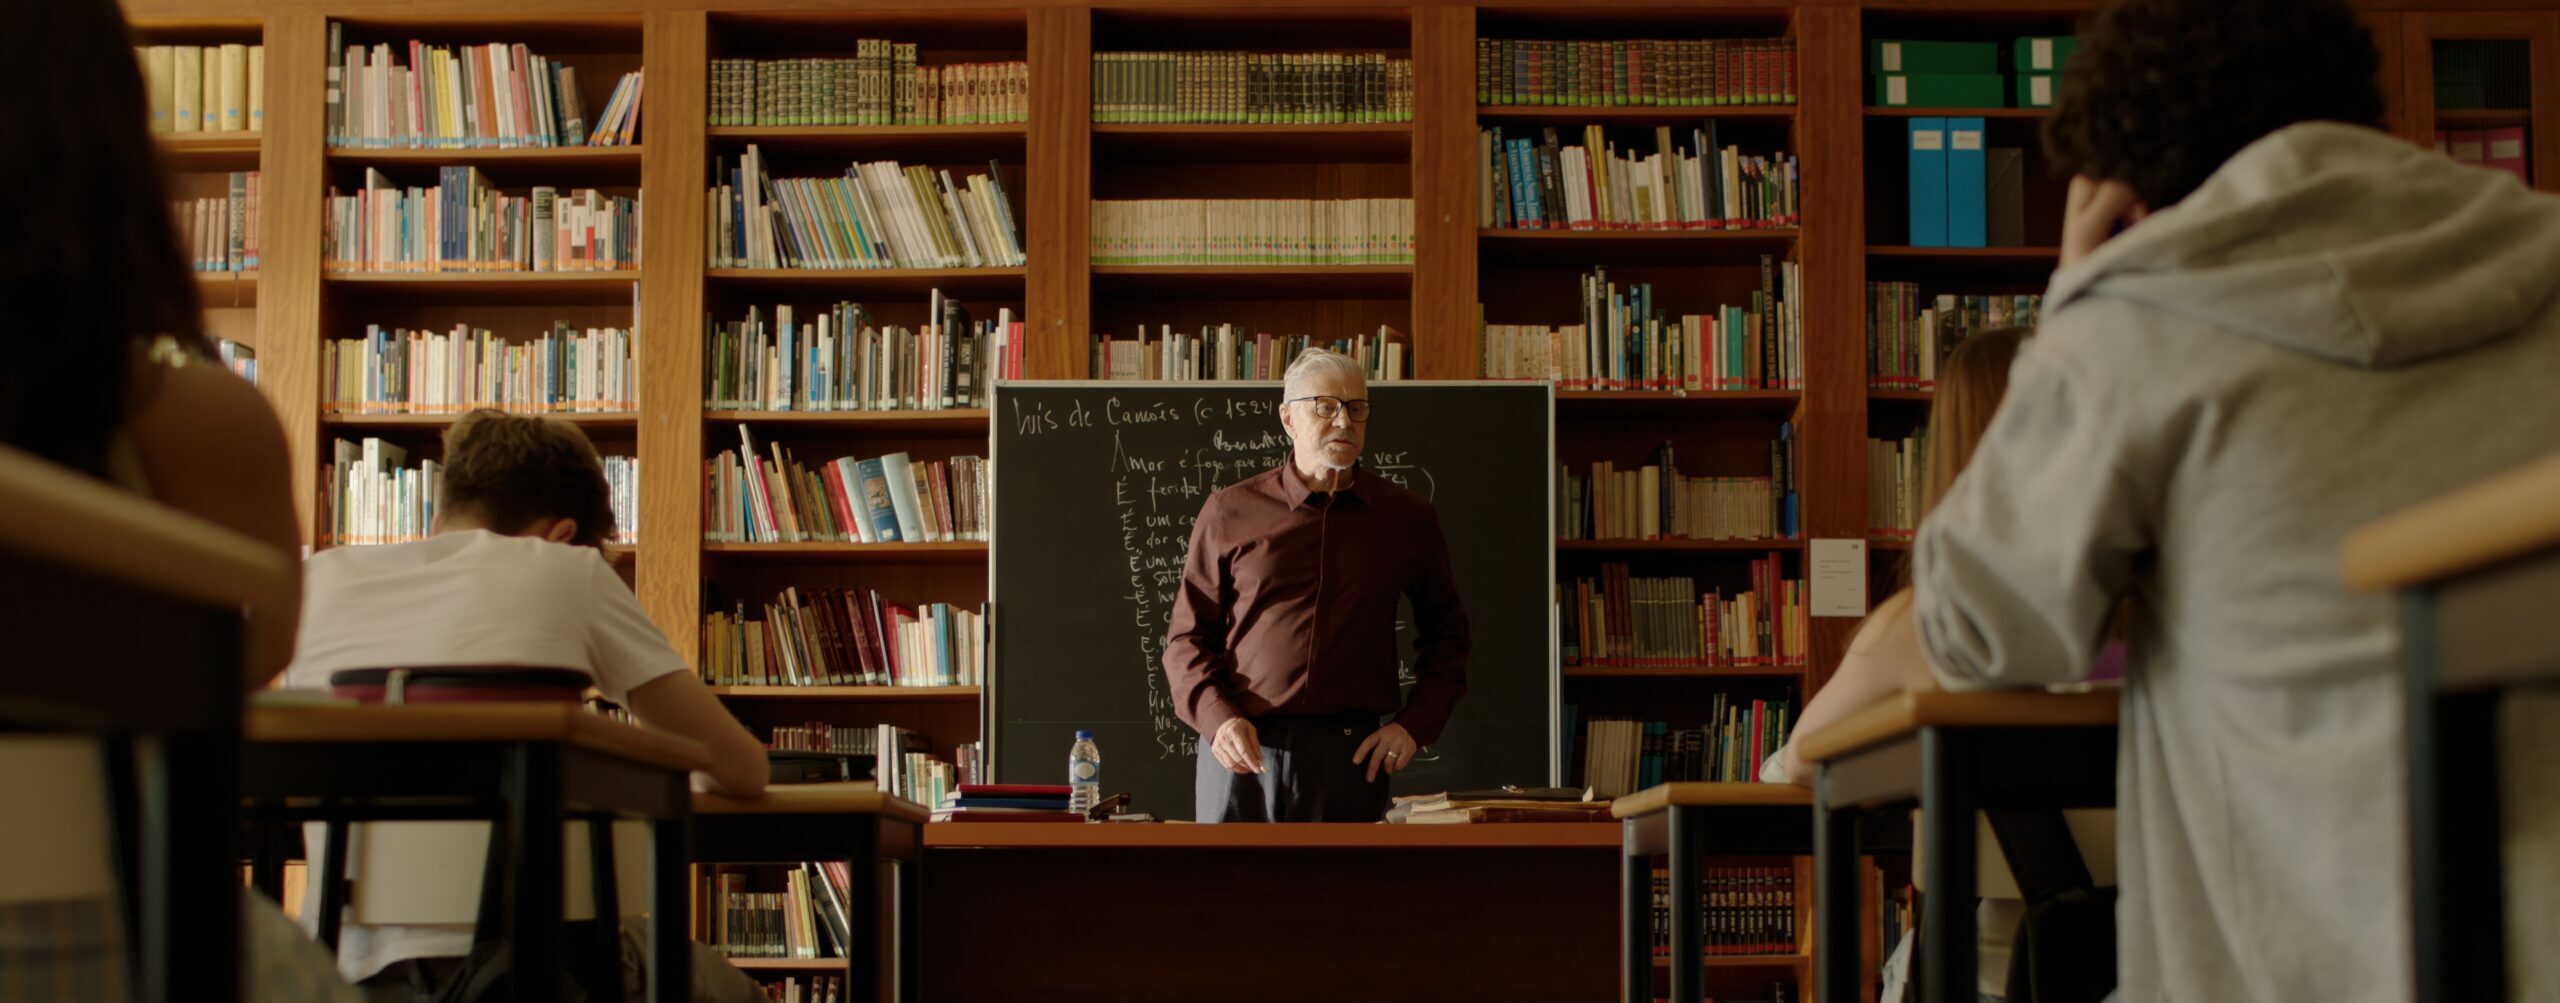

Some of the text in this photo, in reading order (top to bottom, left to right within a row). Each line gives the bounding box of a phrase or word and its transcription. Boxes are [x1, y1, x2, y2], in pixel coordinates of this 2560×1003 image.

[1068, 399, 1094, 428] de
[1110, 429, 1164, 473] Amor
[1374, 451, 1408, 465] ver
[1146, 531, 1168, 548] dor
